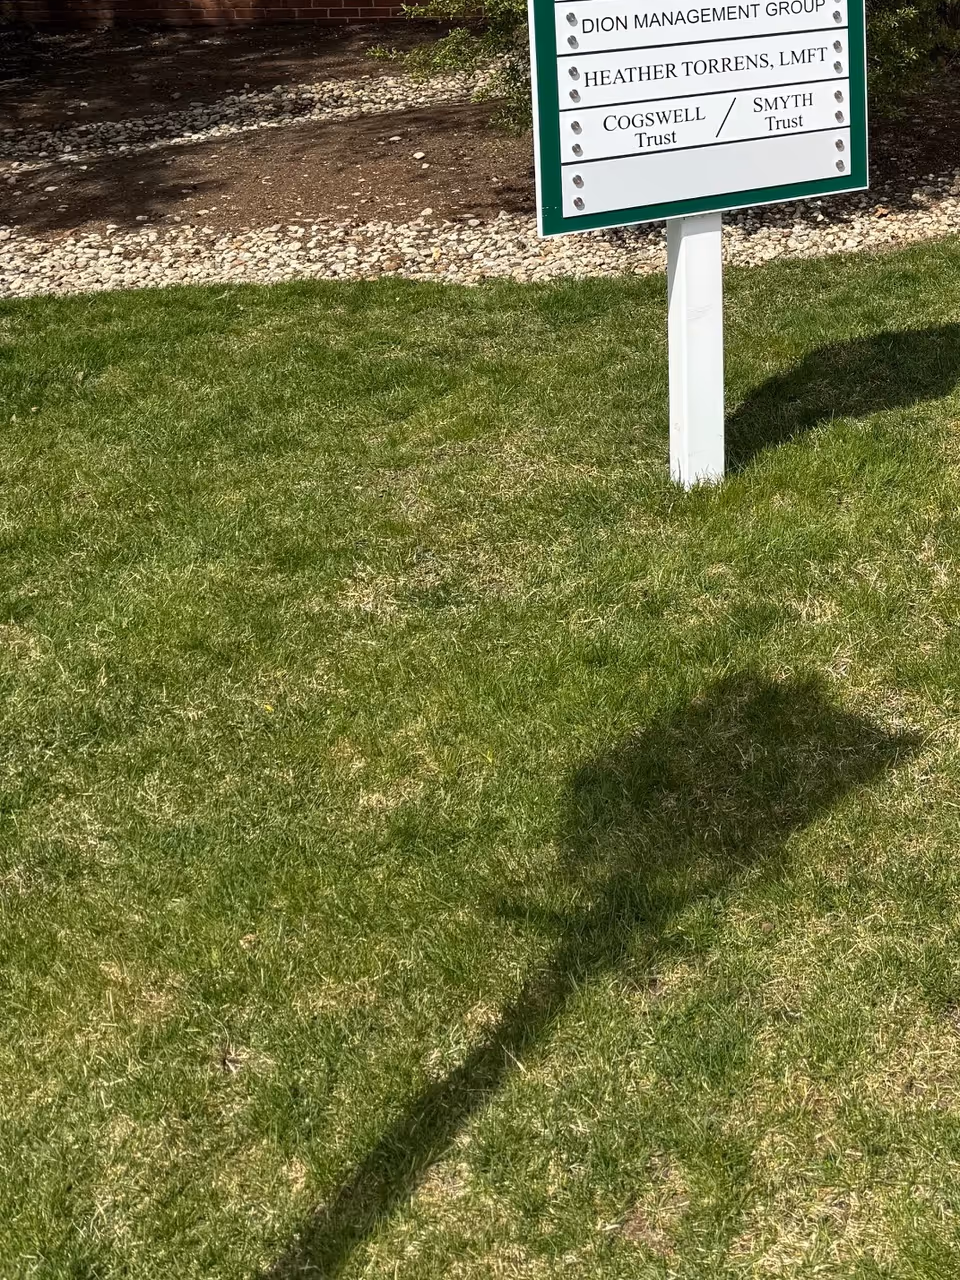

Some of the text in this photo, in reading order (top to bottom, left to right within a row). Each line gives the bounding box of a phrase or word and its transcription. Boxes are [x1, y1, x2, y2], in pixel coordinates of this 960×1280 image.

[581, 16, 628, 34] DION
[634, 4, 761, 29] MANAGEMENT
[584, 47, 828, 88] HEATHER TORRENS, LMFT
[602, 106, 706, 132] COGSWELL
[753, 93, 813, 113] SMYTH
[765, 115, 804, 131] Trust
[635, 131, 678, 148] Trust
